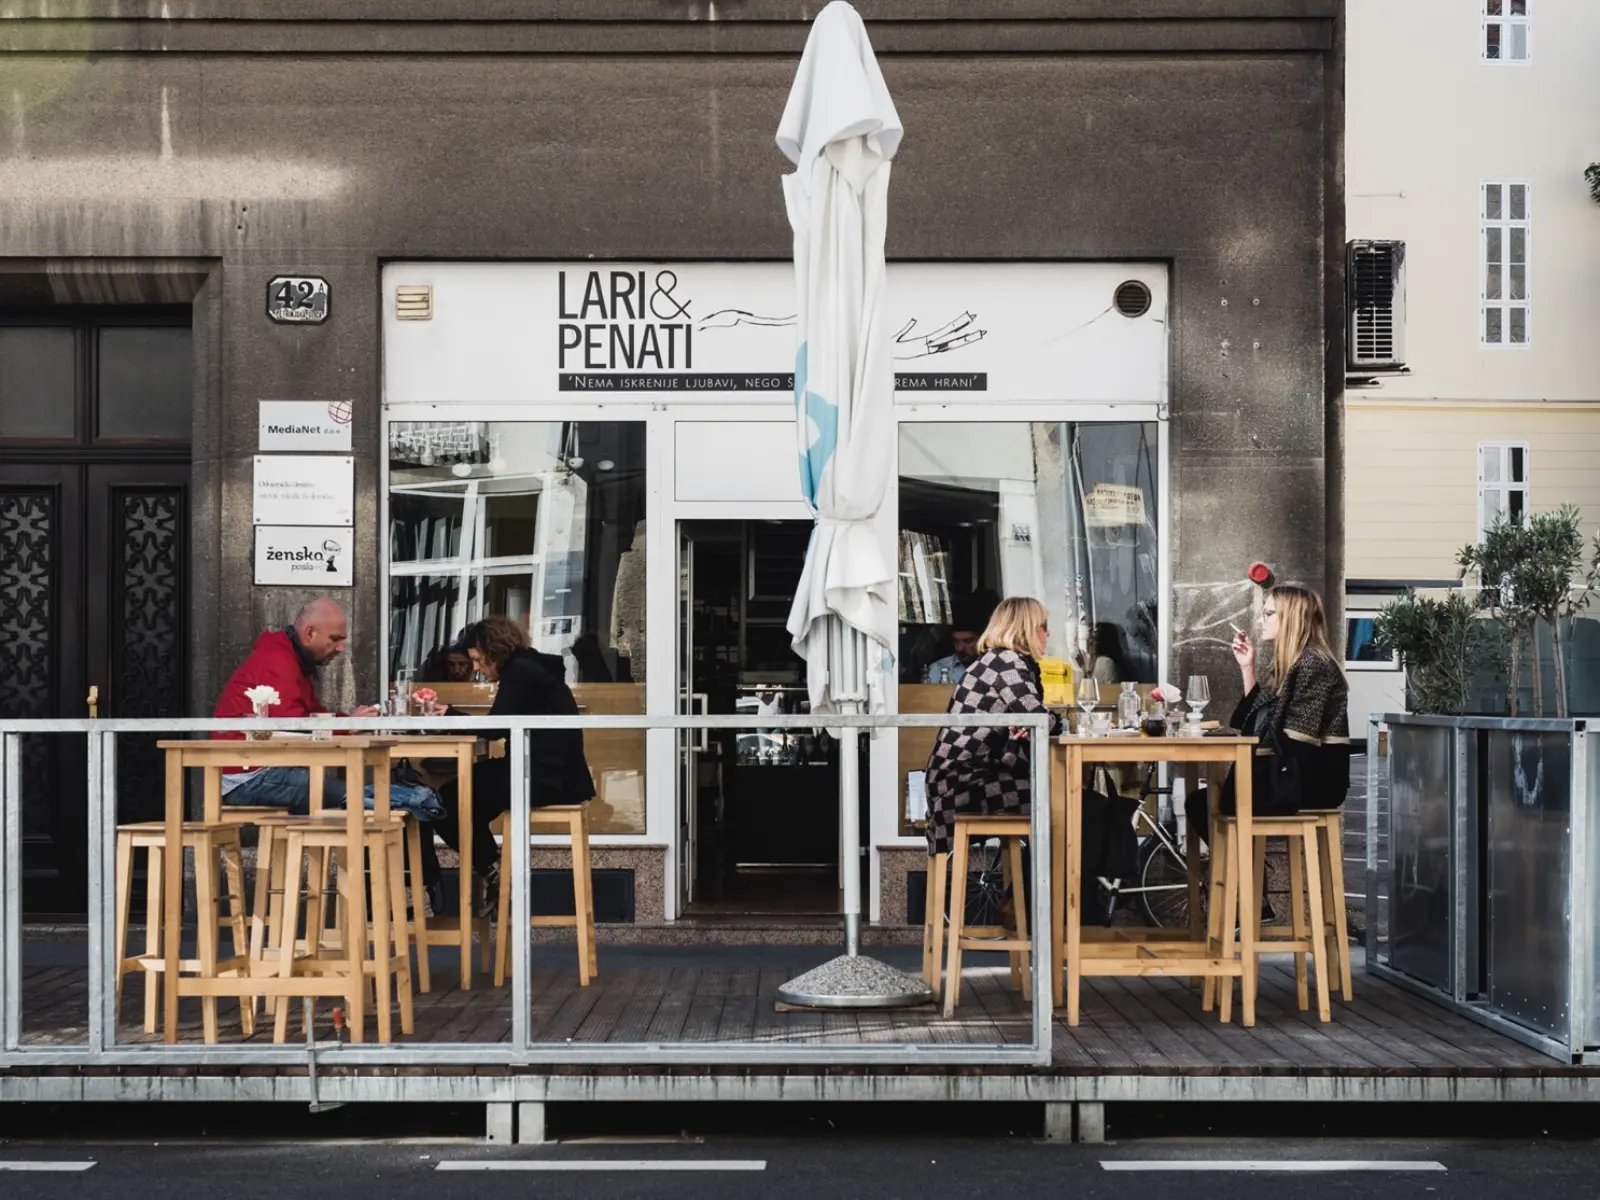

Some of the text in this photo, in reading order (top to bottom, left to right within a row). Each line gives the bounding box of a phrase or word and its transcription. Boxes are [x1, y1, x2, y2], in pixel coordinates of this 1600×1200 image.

[558, 323, 692, 369] PENATI
[620, 378, 679, 389] ISKRENIJE
[685, 378, 737, 391] LJUBAVI,
[745, 378, 781, 388] NEGO
[267, 425, 321, 435] MediaNet
[266, 546, 325, 561] ženska
